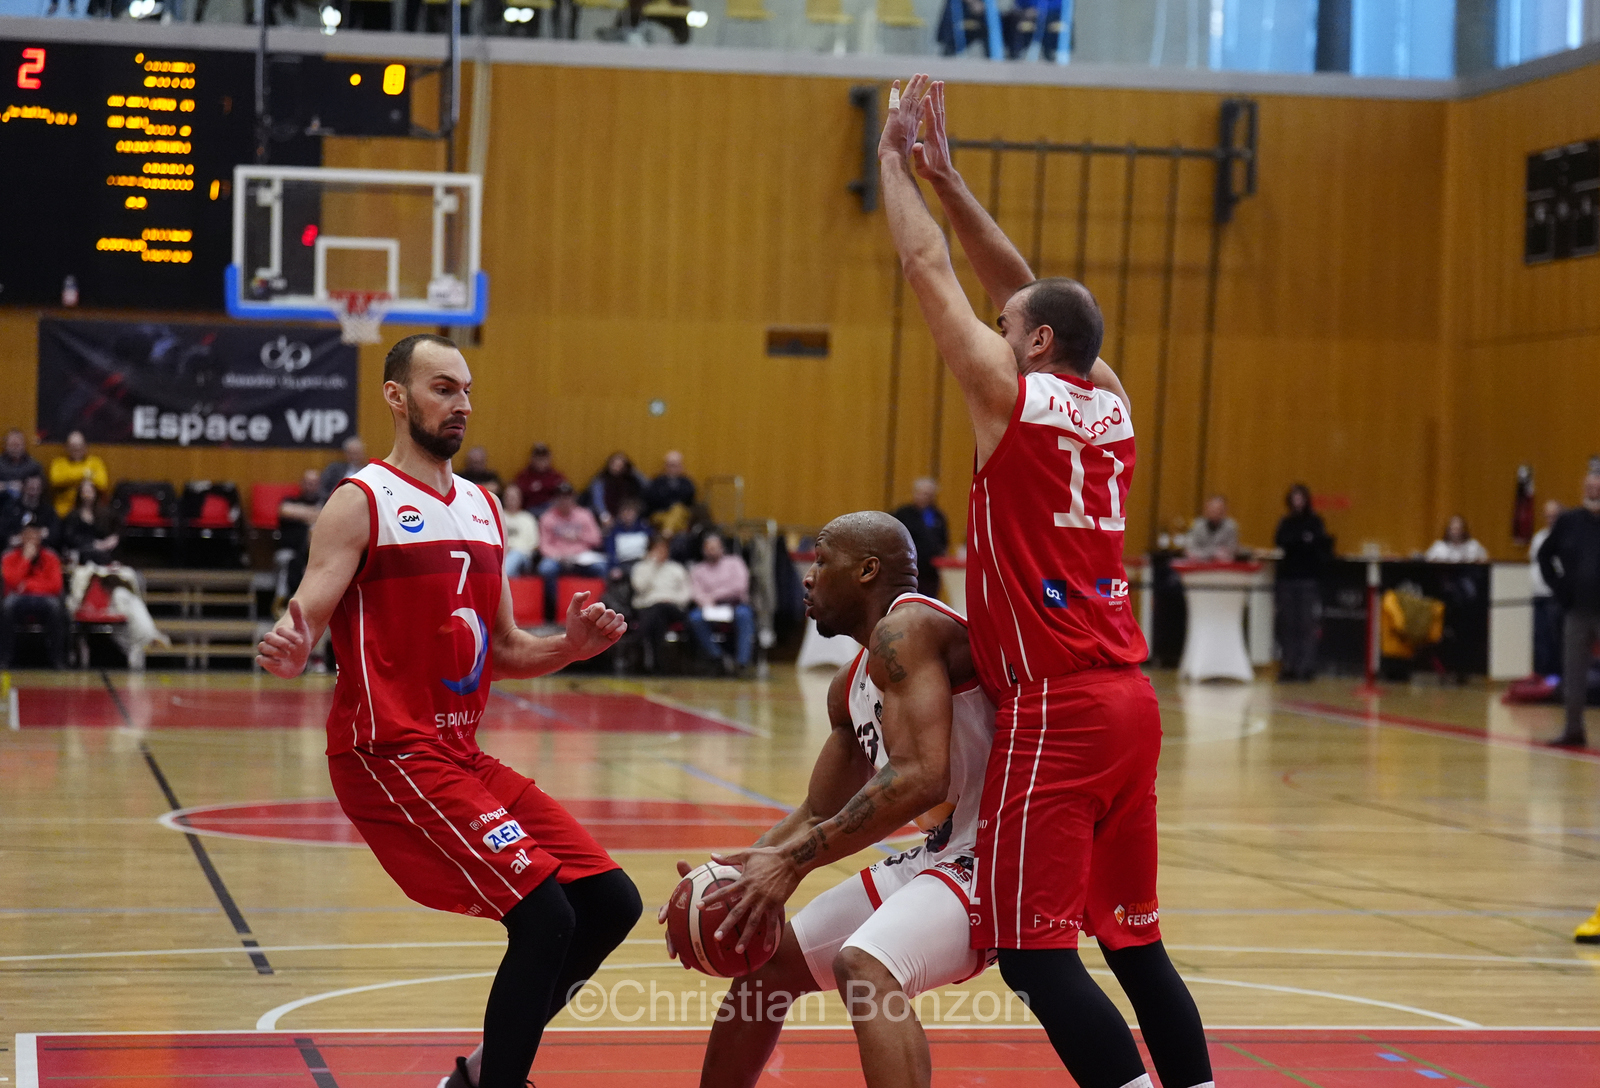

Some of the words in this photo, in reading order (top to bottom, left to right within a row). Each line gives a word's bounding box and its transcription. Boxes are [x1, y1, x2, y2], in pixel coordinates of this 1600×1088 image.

[133, 405, 272, 446] Espace
[284, 408, 349, 443] VIP
[1053, 435, 1126, 531] 11
[450, 551, 471, 594] 7
